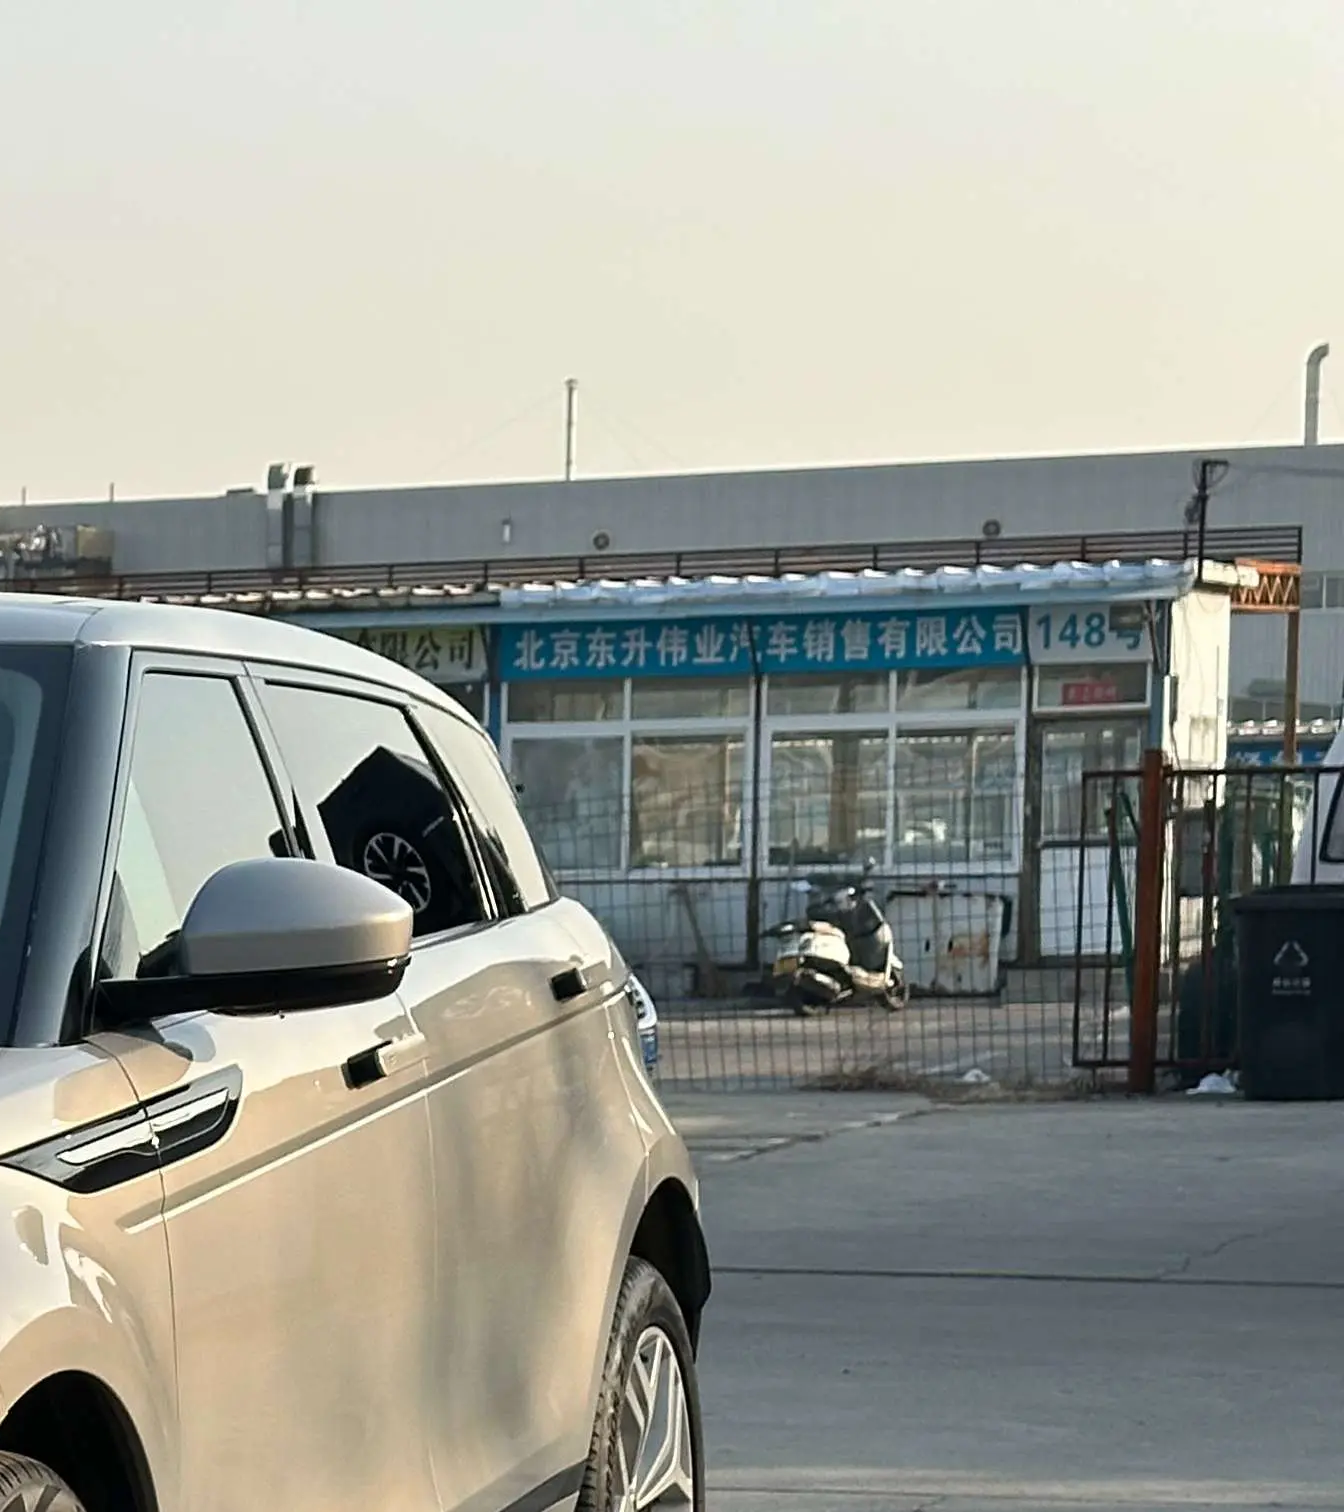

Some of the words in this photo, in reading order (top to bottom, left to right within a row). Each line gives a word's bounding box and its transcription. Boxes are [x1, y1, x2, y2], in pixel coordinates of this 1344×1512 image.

[513, 614, 1022, 670] 北京东升伟业汽车销售有限公司
